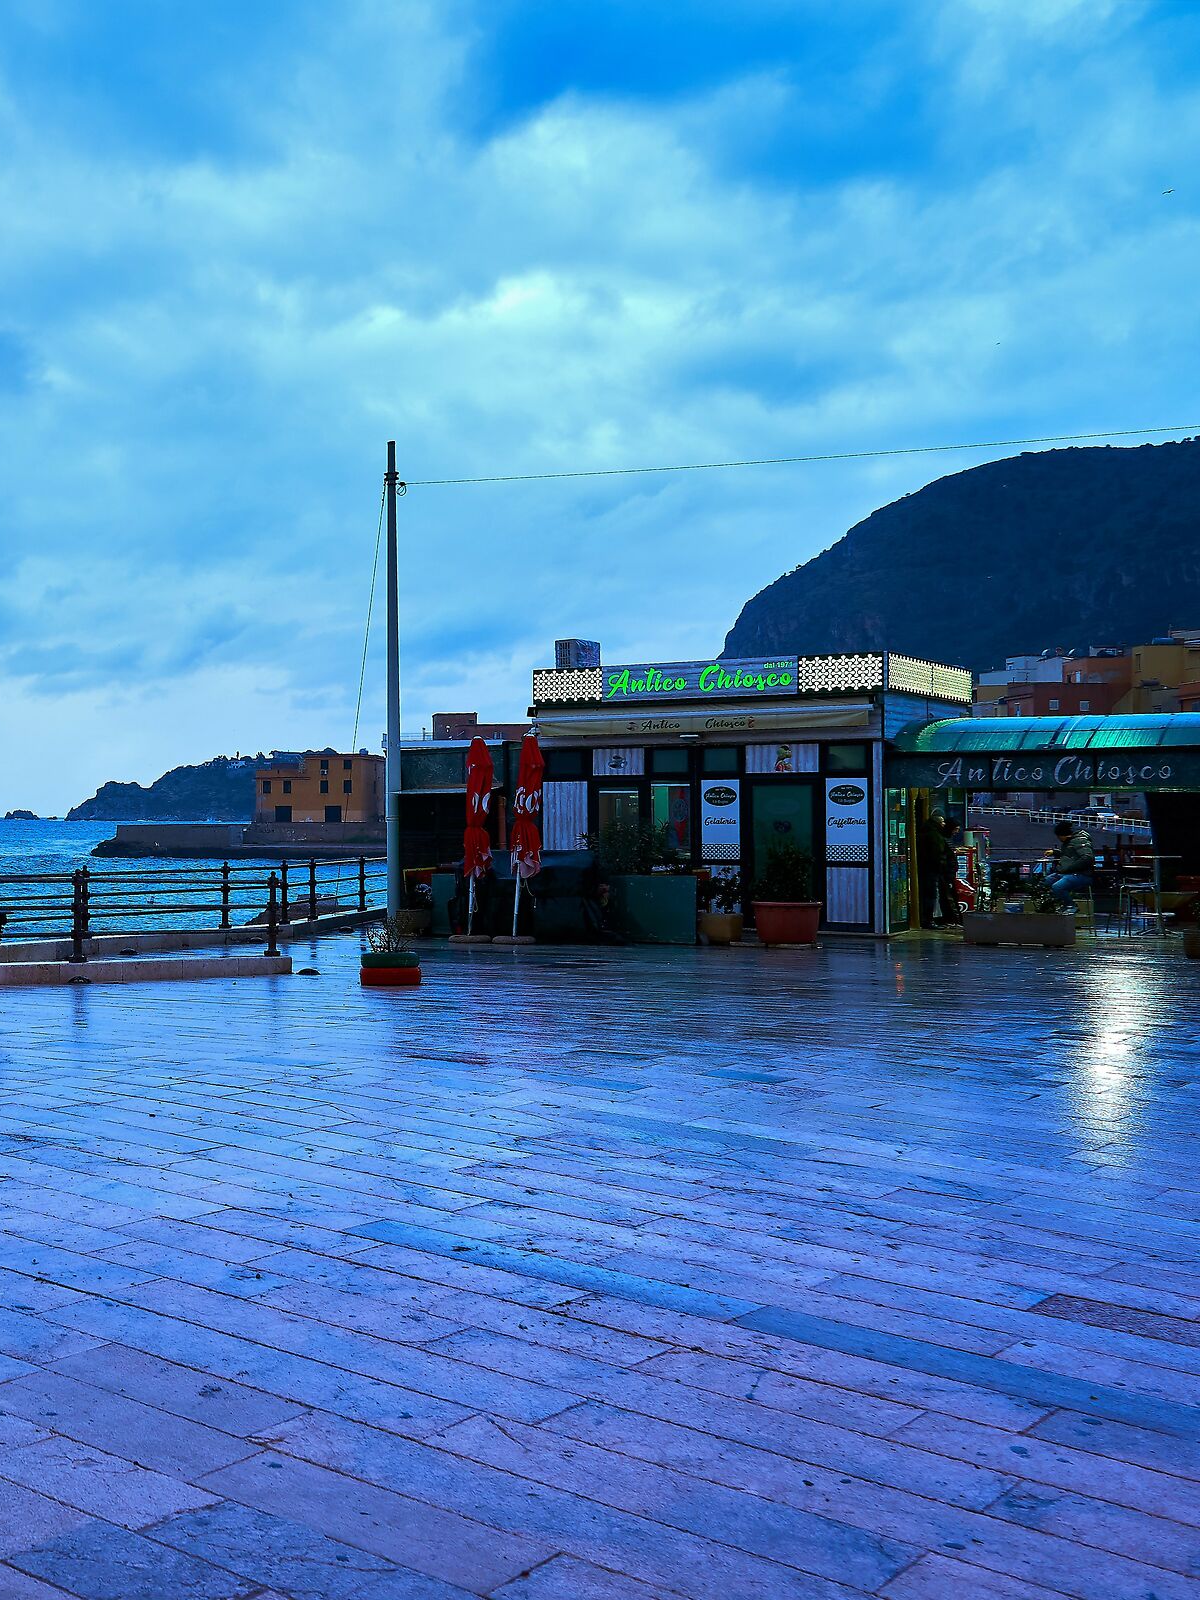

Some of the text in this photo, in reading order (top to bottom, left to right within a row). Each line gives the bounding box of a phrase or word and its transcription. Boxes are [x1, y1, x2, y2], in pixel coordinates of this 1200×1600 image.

[606, 664, 793, 698] Antico Chiosco
[641, 718, 745, 732] Antico Chiosco
[935, 756, 1174, 788] Antico Chiosco
[704, 816, 736, 825] Gelateria
[827, 816, 866, 828] Caffetteria
